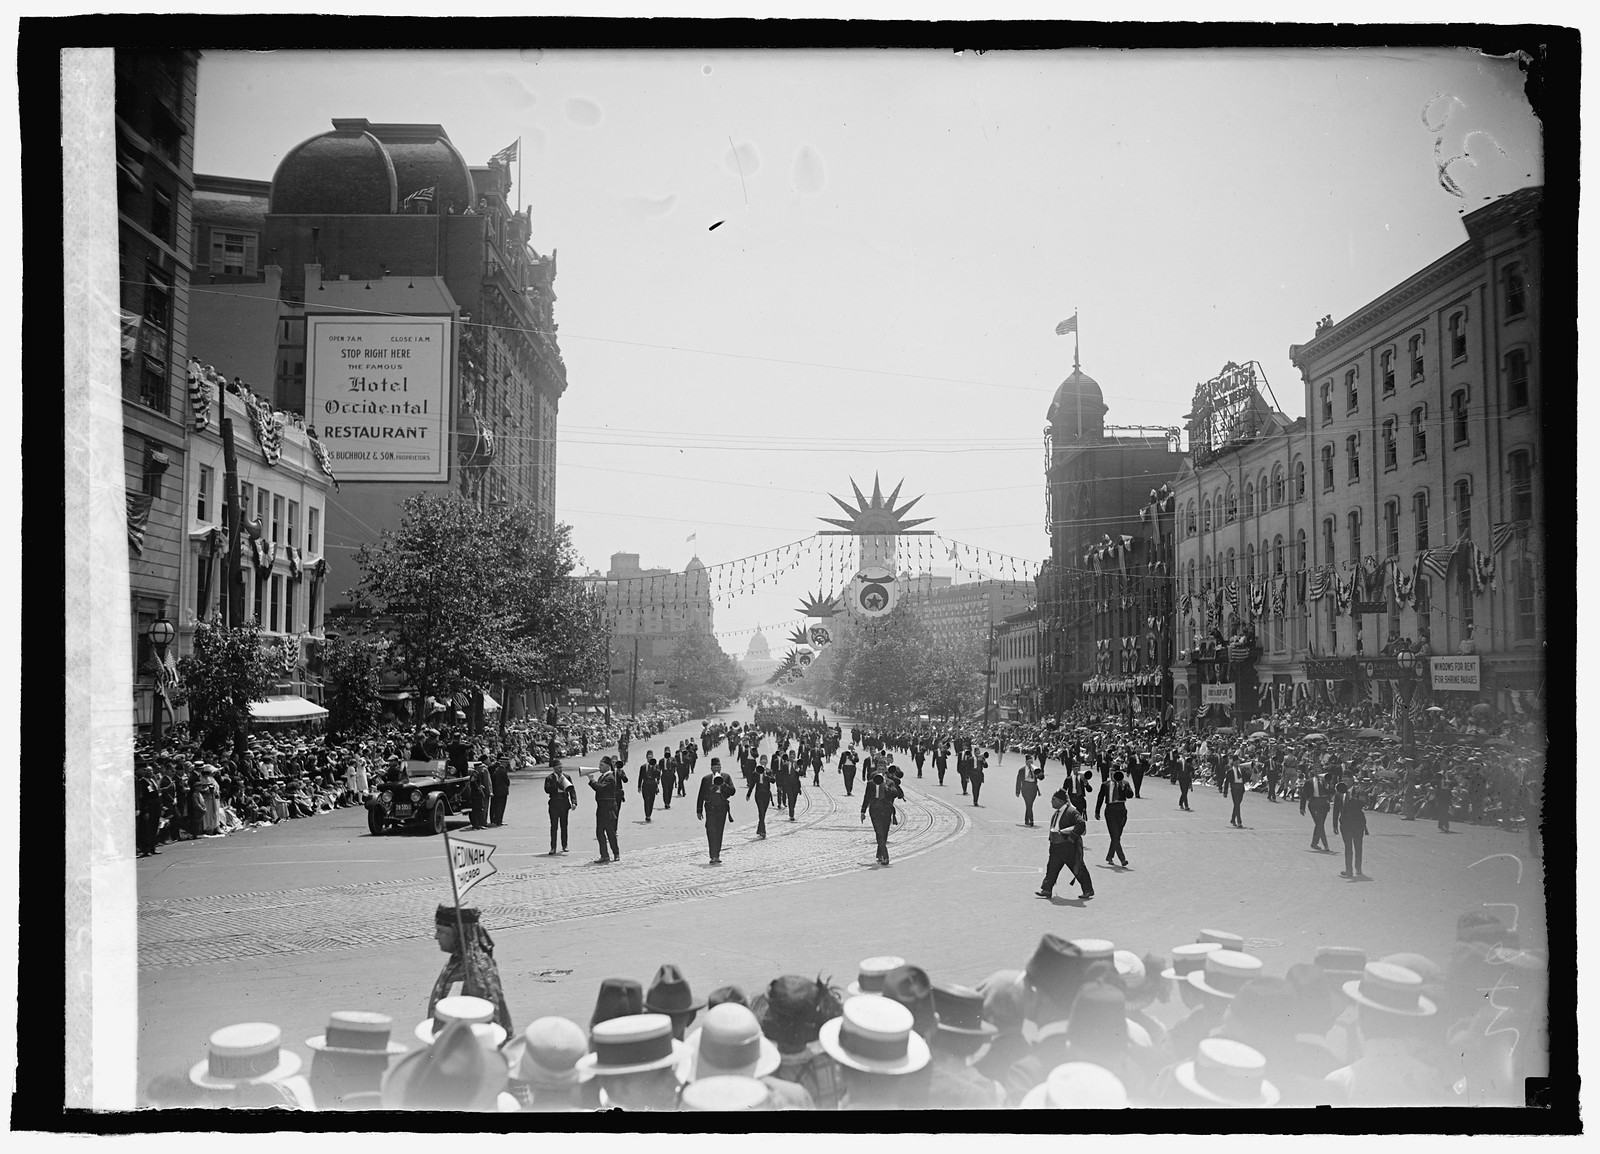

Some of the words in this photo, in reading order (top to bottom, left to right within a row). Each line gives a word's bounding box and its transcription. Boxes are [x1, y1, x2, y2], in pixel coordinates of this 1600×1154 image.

[341, 348, 361, 359] STOP
[364, 348, 388, 359] RIGHT
[390, 348, 411, 359] HERE
[348, 377, 408, 392] Hotel
[325, 399, 428, 415] Occidental
[325, 426, 428, 439] RESTAURANT
[336, 451, 371, 460] BUCHHOLZ
[372, 451, 378, 460] &
[1434, 662, 1454, 671] WINDOWS
[1454, 662, 1464, 671] FOR
[1464, 662, 1476, 671] RENT
[1435, 675, 1444, 684] FOR
[1444, 675, 1460, 684] SHRINE
[1460, 675, 1477, 684] PARADES
